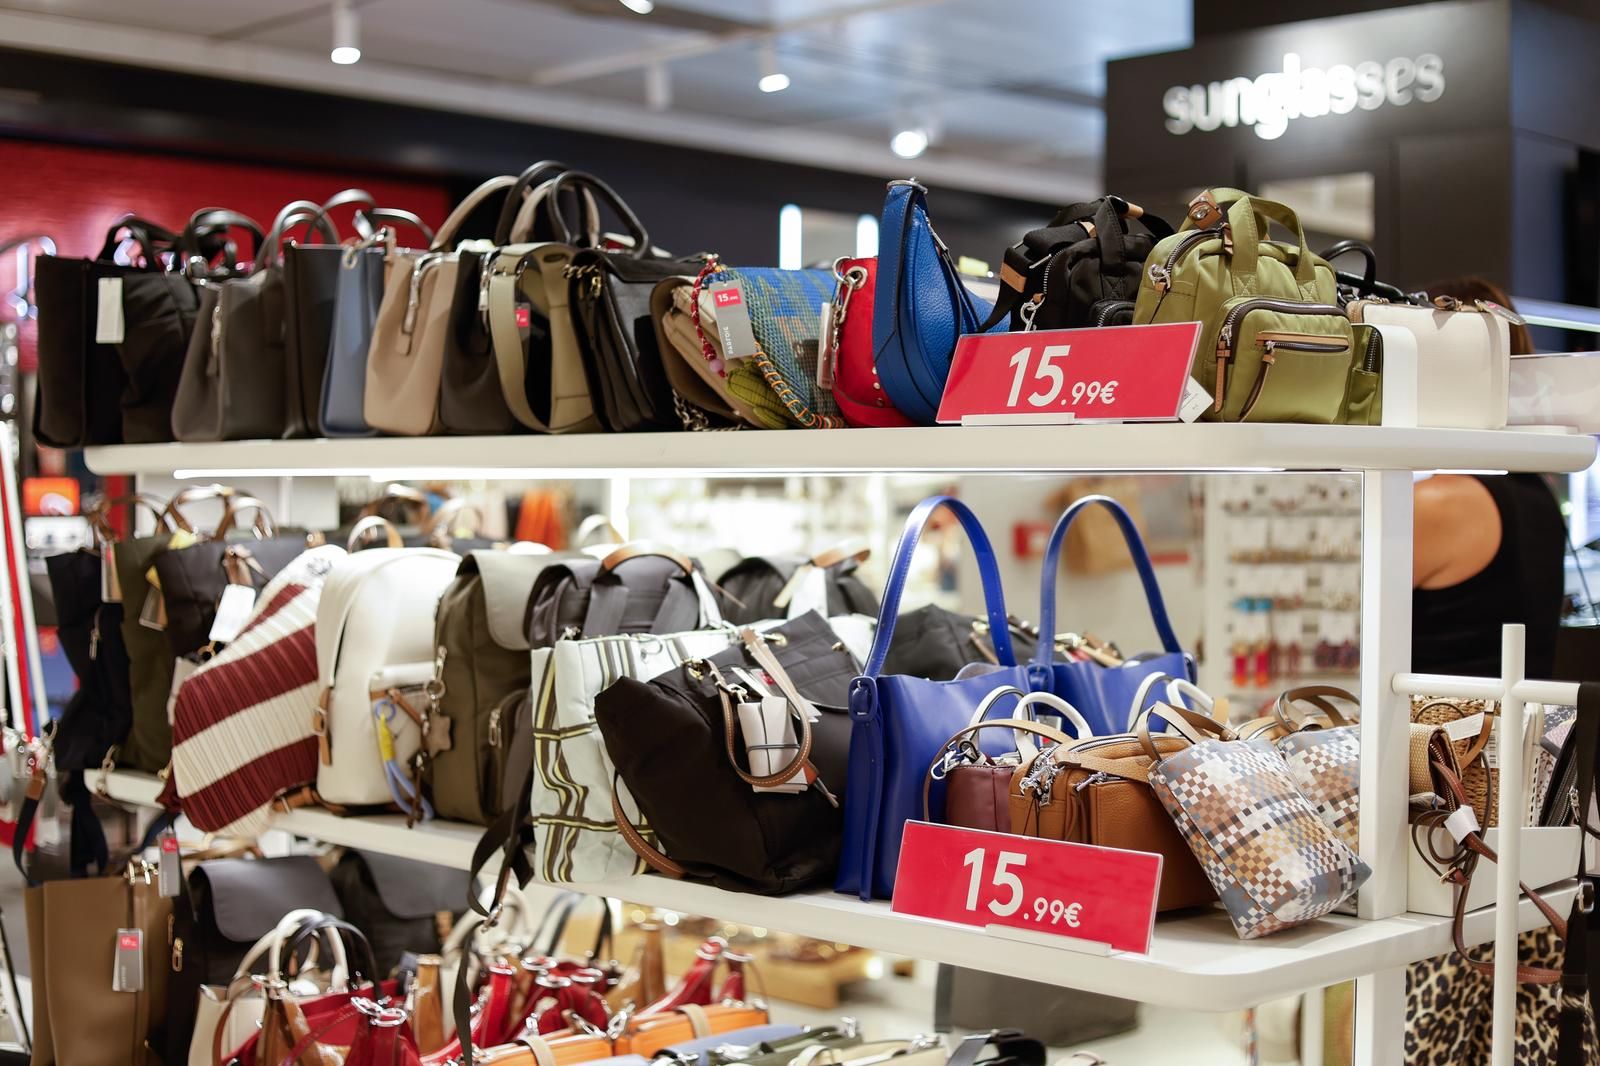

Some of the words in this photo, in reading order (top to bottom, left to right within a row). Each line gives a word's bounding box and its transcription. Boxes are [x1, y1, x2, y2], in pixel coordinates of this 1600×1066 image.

[1163, 52, 1446, 140] sunglasses
[1007, 345, 1119, 406] 15.99€
[963, 848, 1083, 928] 15.99€
